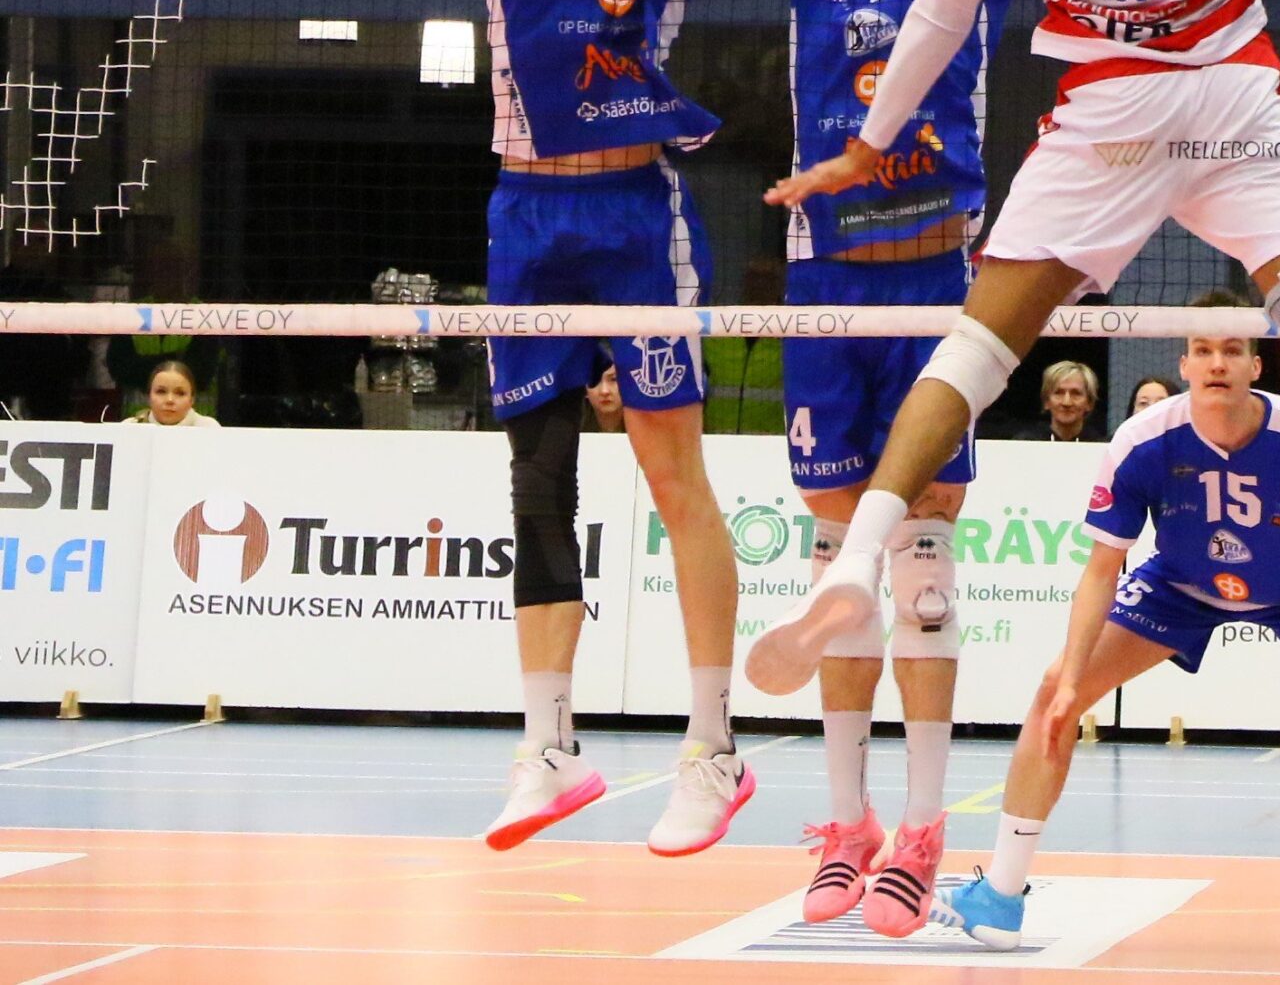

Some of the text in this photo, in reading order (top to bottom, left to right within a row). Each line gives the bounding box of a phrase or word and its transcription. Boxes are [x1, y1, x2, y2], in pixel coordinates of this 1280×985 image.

[161, 309, 248, 329] VEXVE
[256, 310, 294, 330] OY
[438, 312, 528, 333] VEXVE
[534, 312, 572, 333] OY
[719, 313, 809, 334] VEXVE
[817, 313, 855, 334] OY
[1047, 312, 1094, 333] XVE
[1101, 311, 1140, 333] OY
[505, 373, 555, 404] SEUTU
[0, 440, 113, 511] STI
[813, 455, 865, 476] SEUTU
[1198, 470, 1262, 528] 15
[279, 516, 604, 580] Turrinsl
[168, 593, 363, 619] ASENNUKSEN
[15, 641, 114, 668] viikko.
